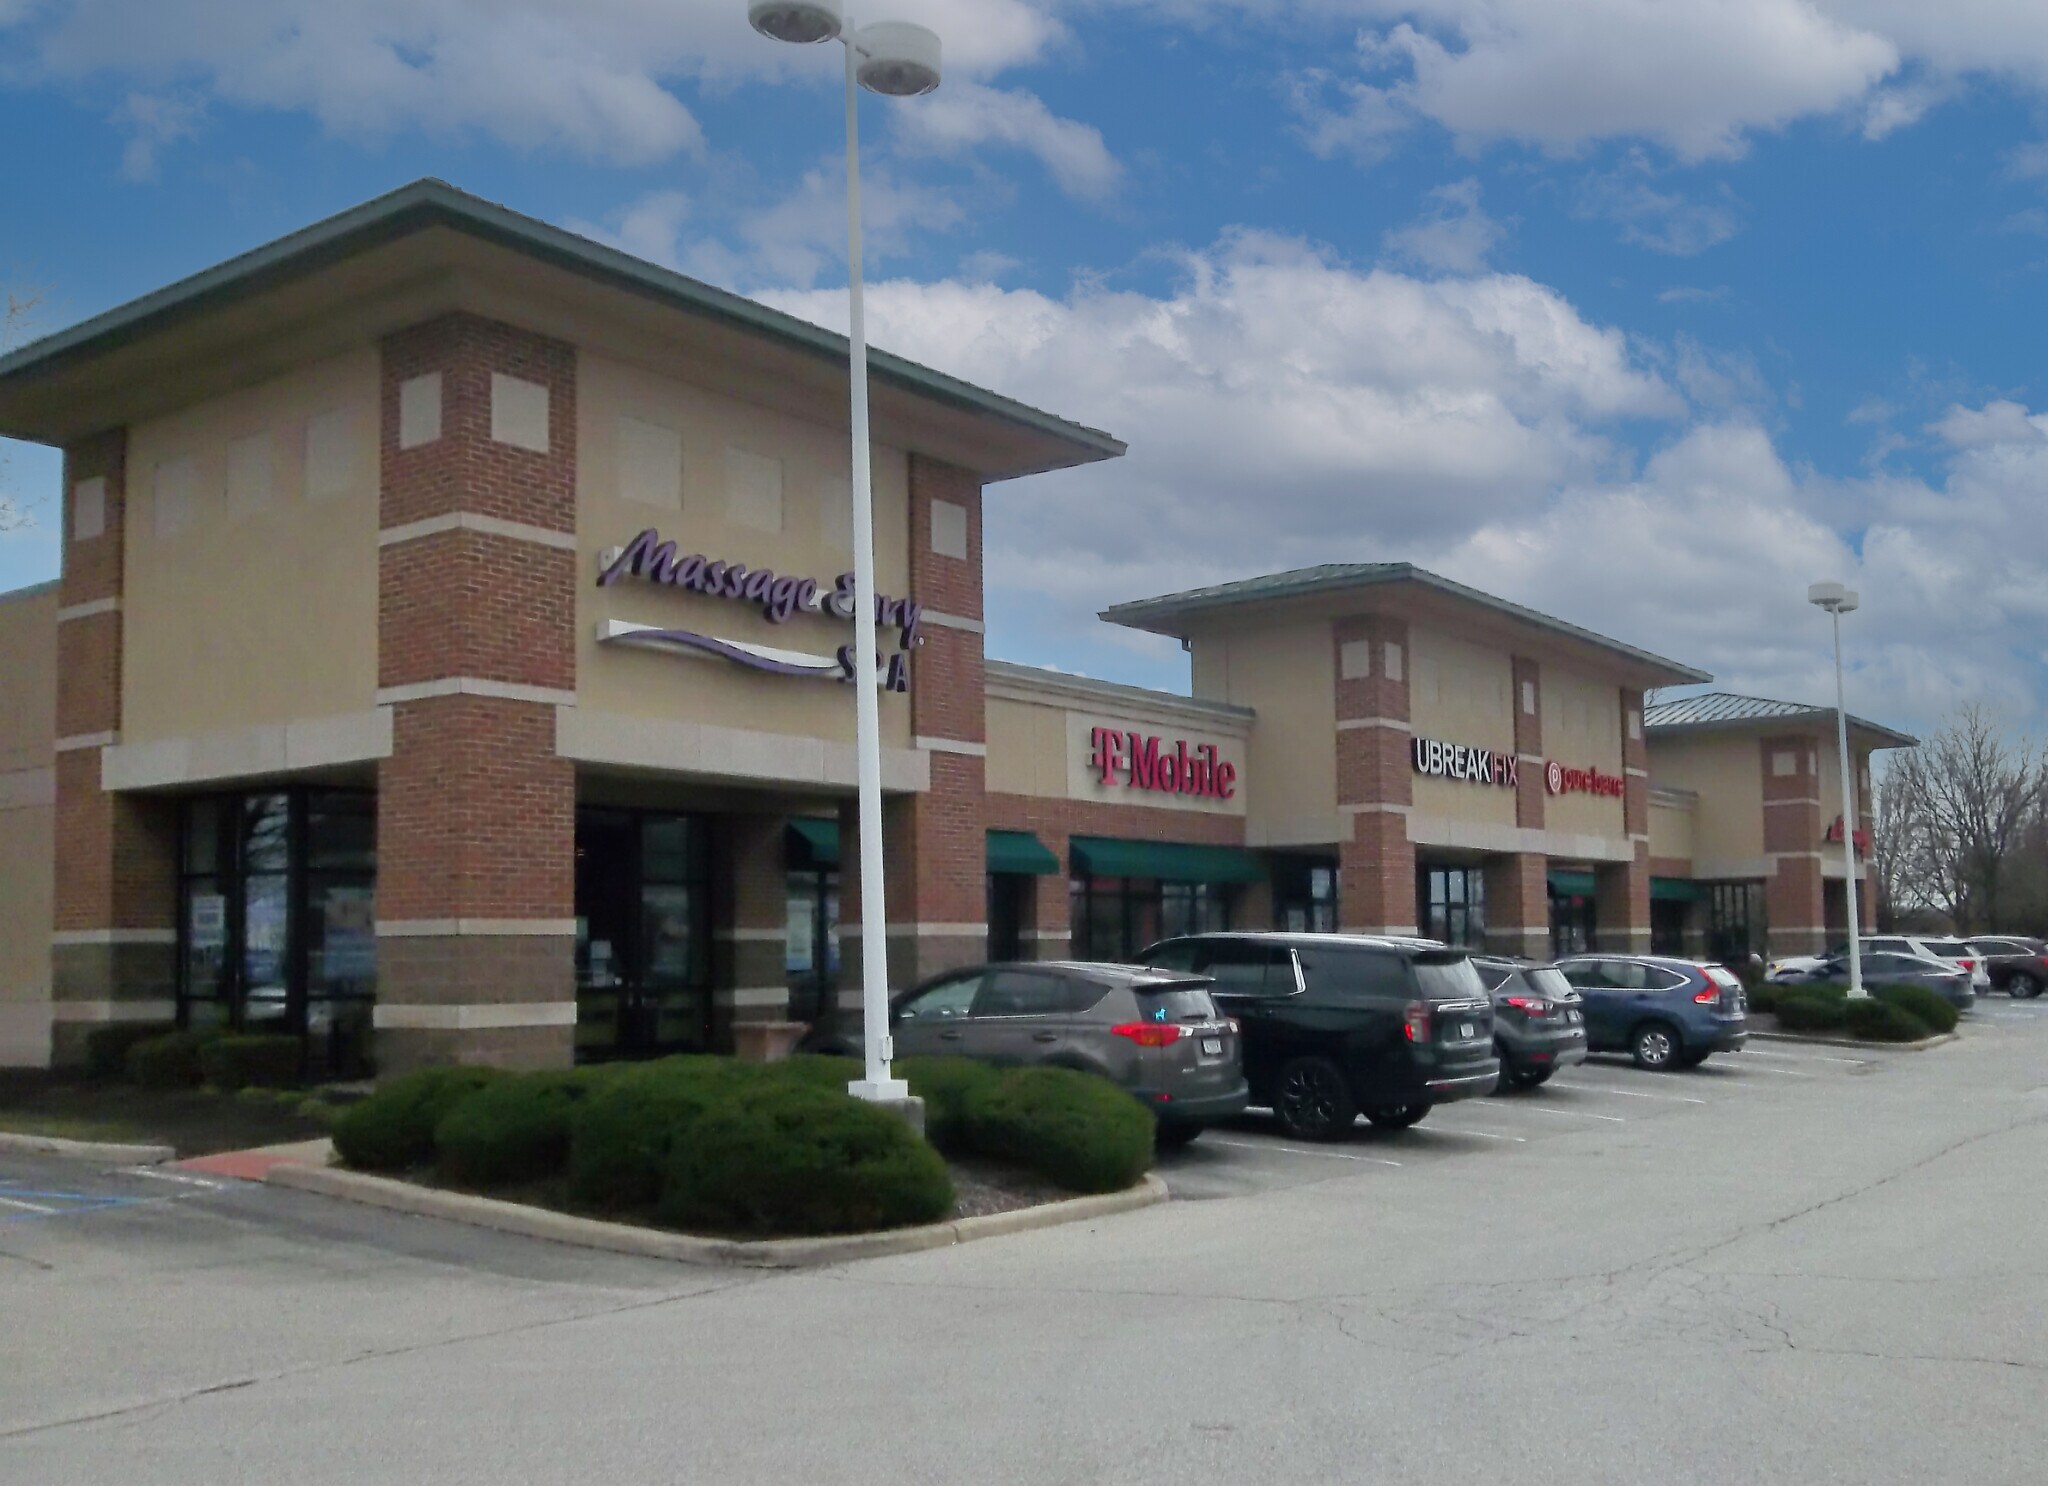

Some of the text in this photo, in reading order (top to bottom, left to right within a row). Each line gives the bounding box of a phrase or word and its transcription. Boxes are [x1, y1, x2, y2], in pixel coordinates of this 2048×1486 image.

[596, 527, 817, 624] Massage
[837, 644, 909, 693] SA
[1412, 737, 1519, 787] UBREAKIFIX
